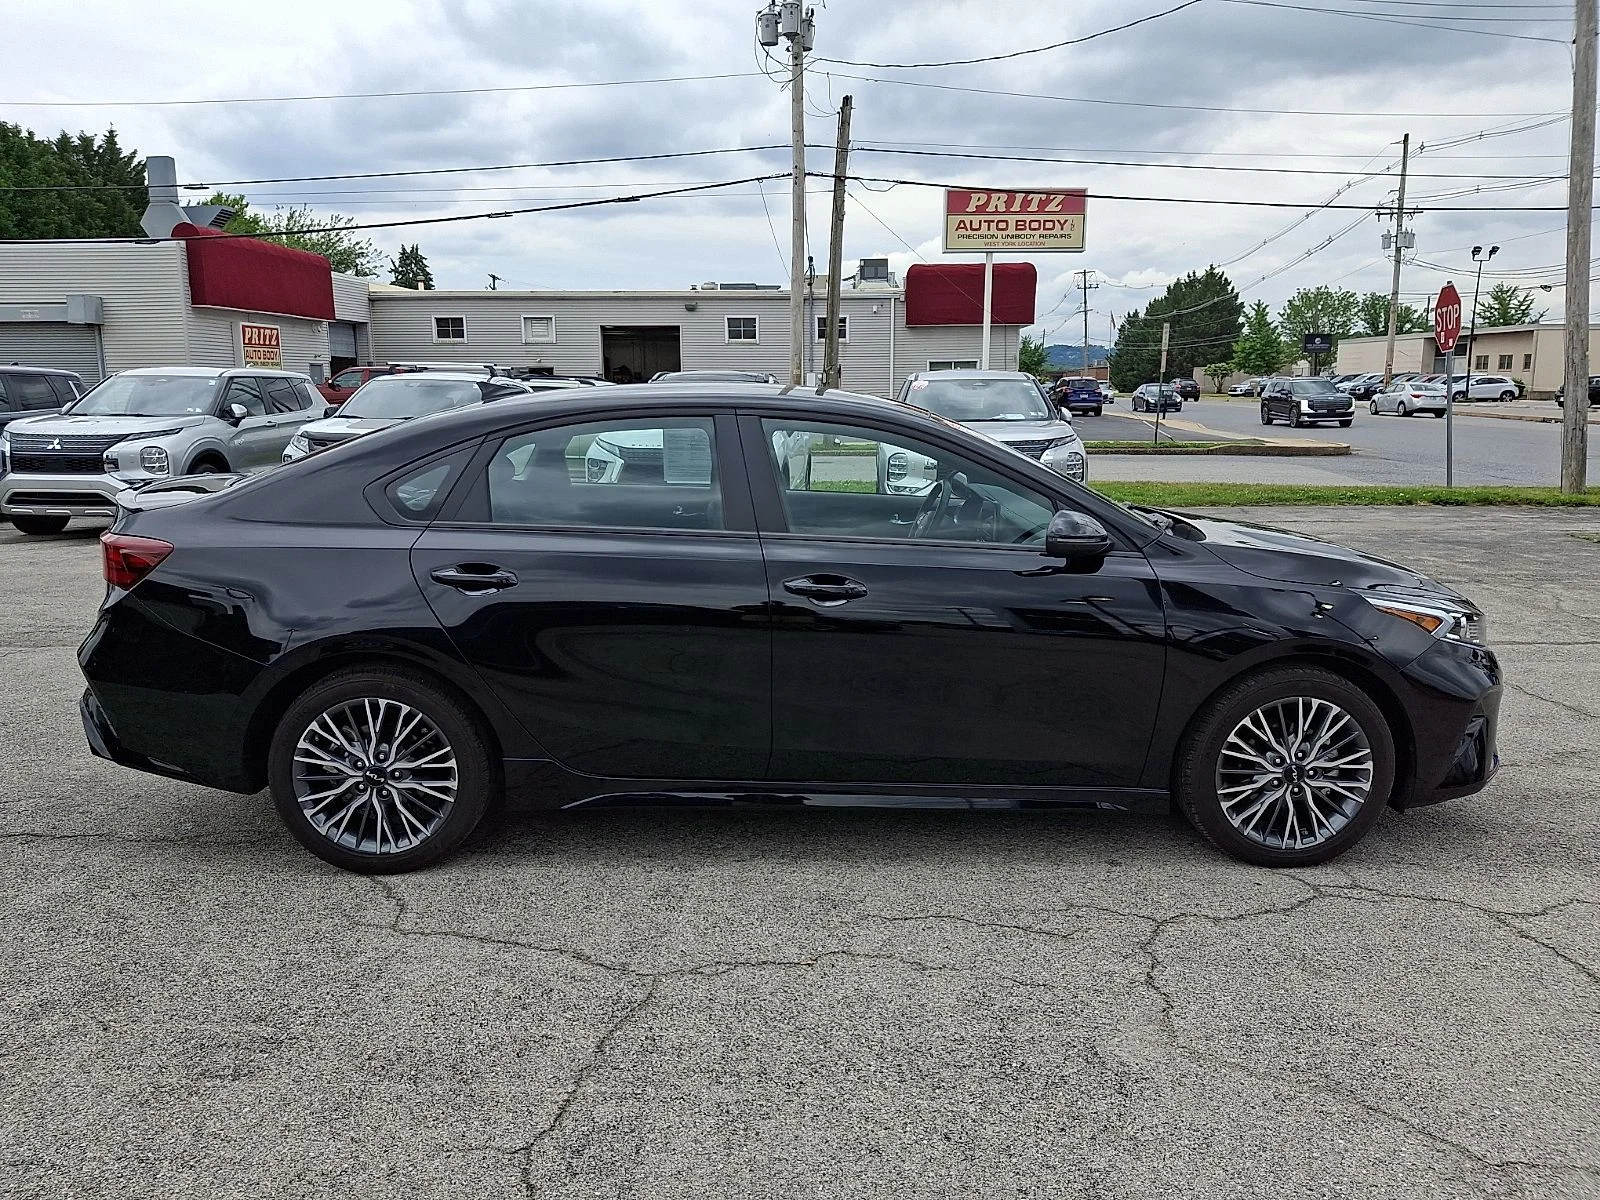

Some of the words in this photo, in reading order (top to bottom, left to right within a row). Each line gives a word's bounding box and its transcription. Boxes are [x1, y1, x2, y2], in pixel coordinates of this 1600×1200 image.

[966, 193, 1066, 212] PRITZ
[955, 219, 1010, 232] AUTO
[1015, 219, 1069, 232] BODY
[1436, 303, 1460, 333] STOP
[244, 327, 278, 346] PRITZ
[245, 349, 262, 360] AUTO
[262, 350, 279, 361] BODY
